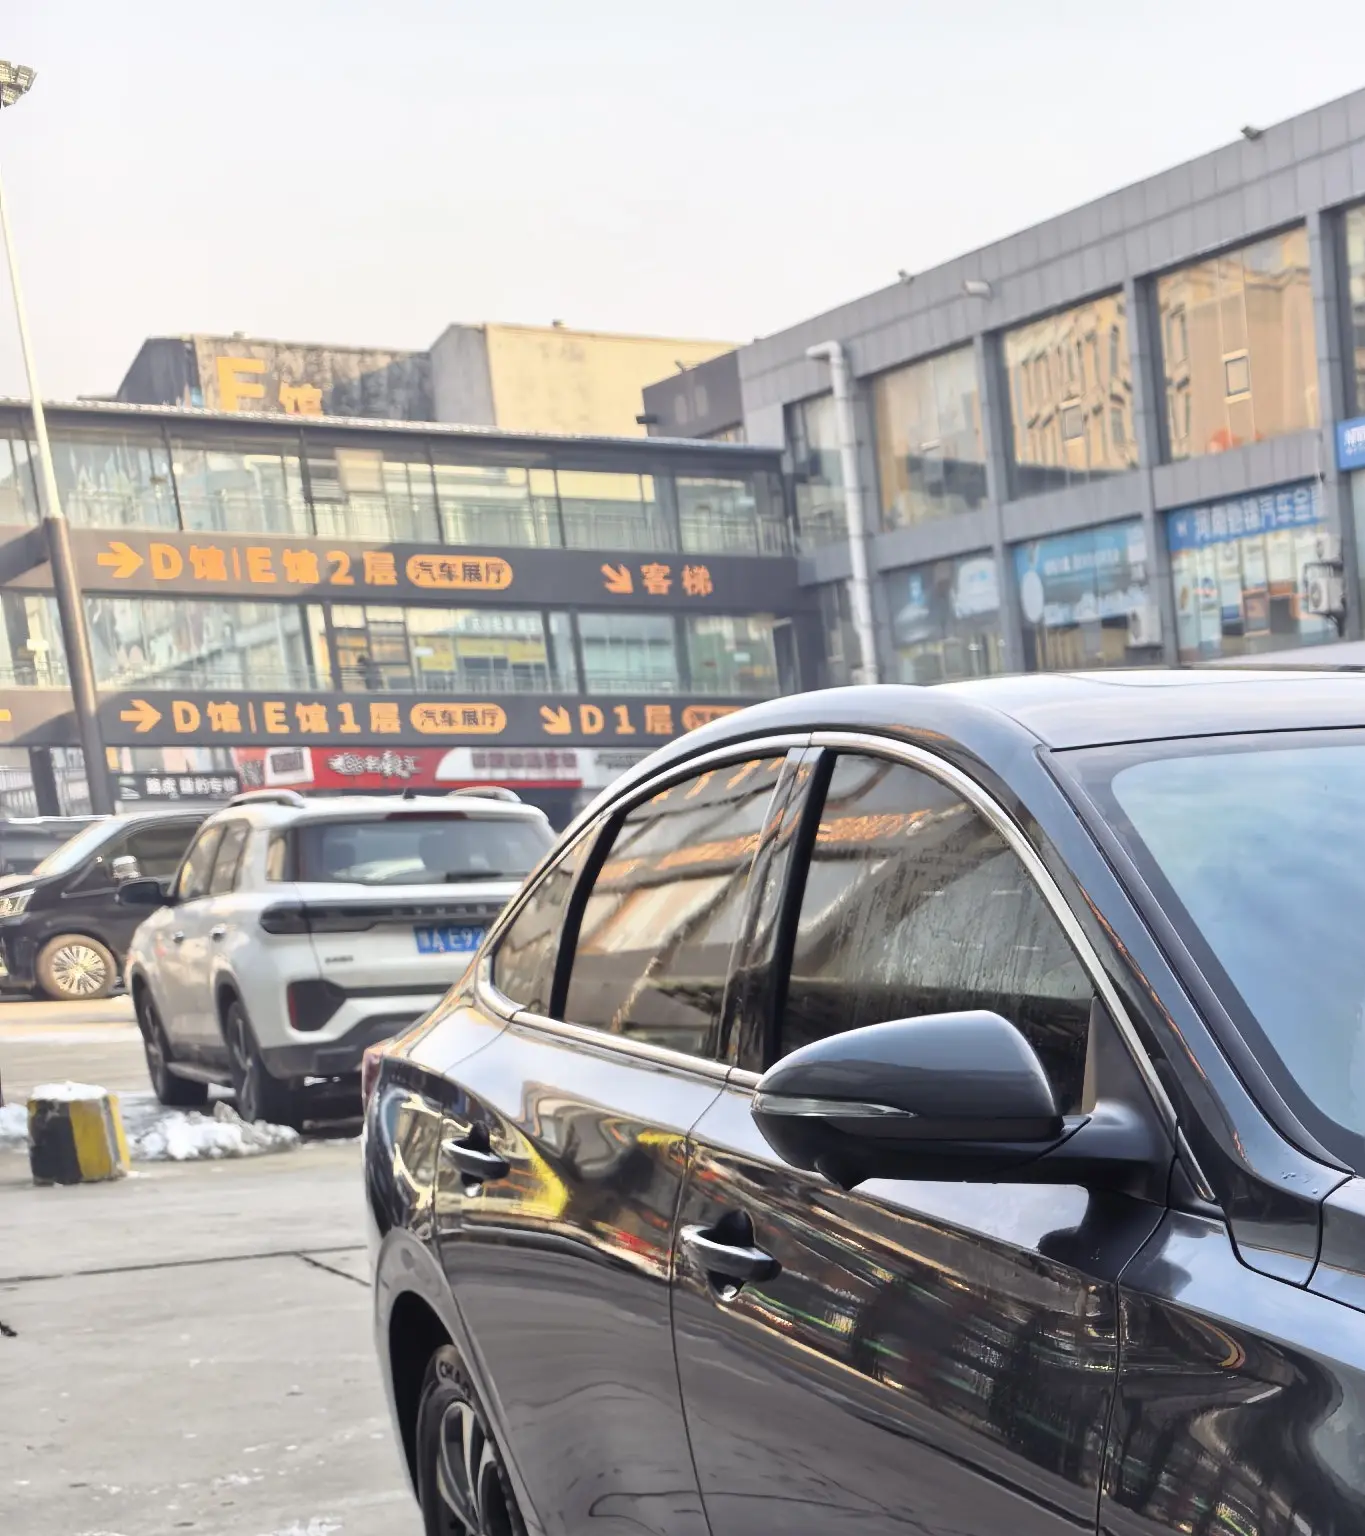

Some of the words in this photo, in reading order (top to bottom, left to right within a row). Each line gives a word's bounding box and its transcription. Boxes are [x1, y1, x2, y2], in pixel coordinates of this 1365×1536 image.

[414, 559, 506, 585] 汽车展厅
[640, 562, 714, 598] 客梯
[419, 706, 500, 728] 汽车展厅
